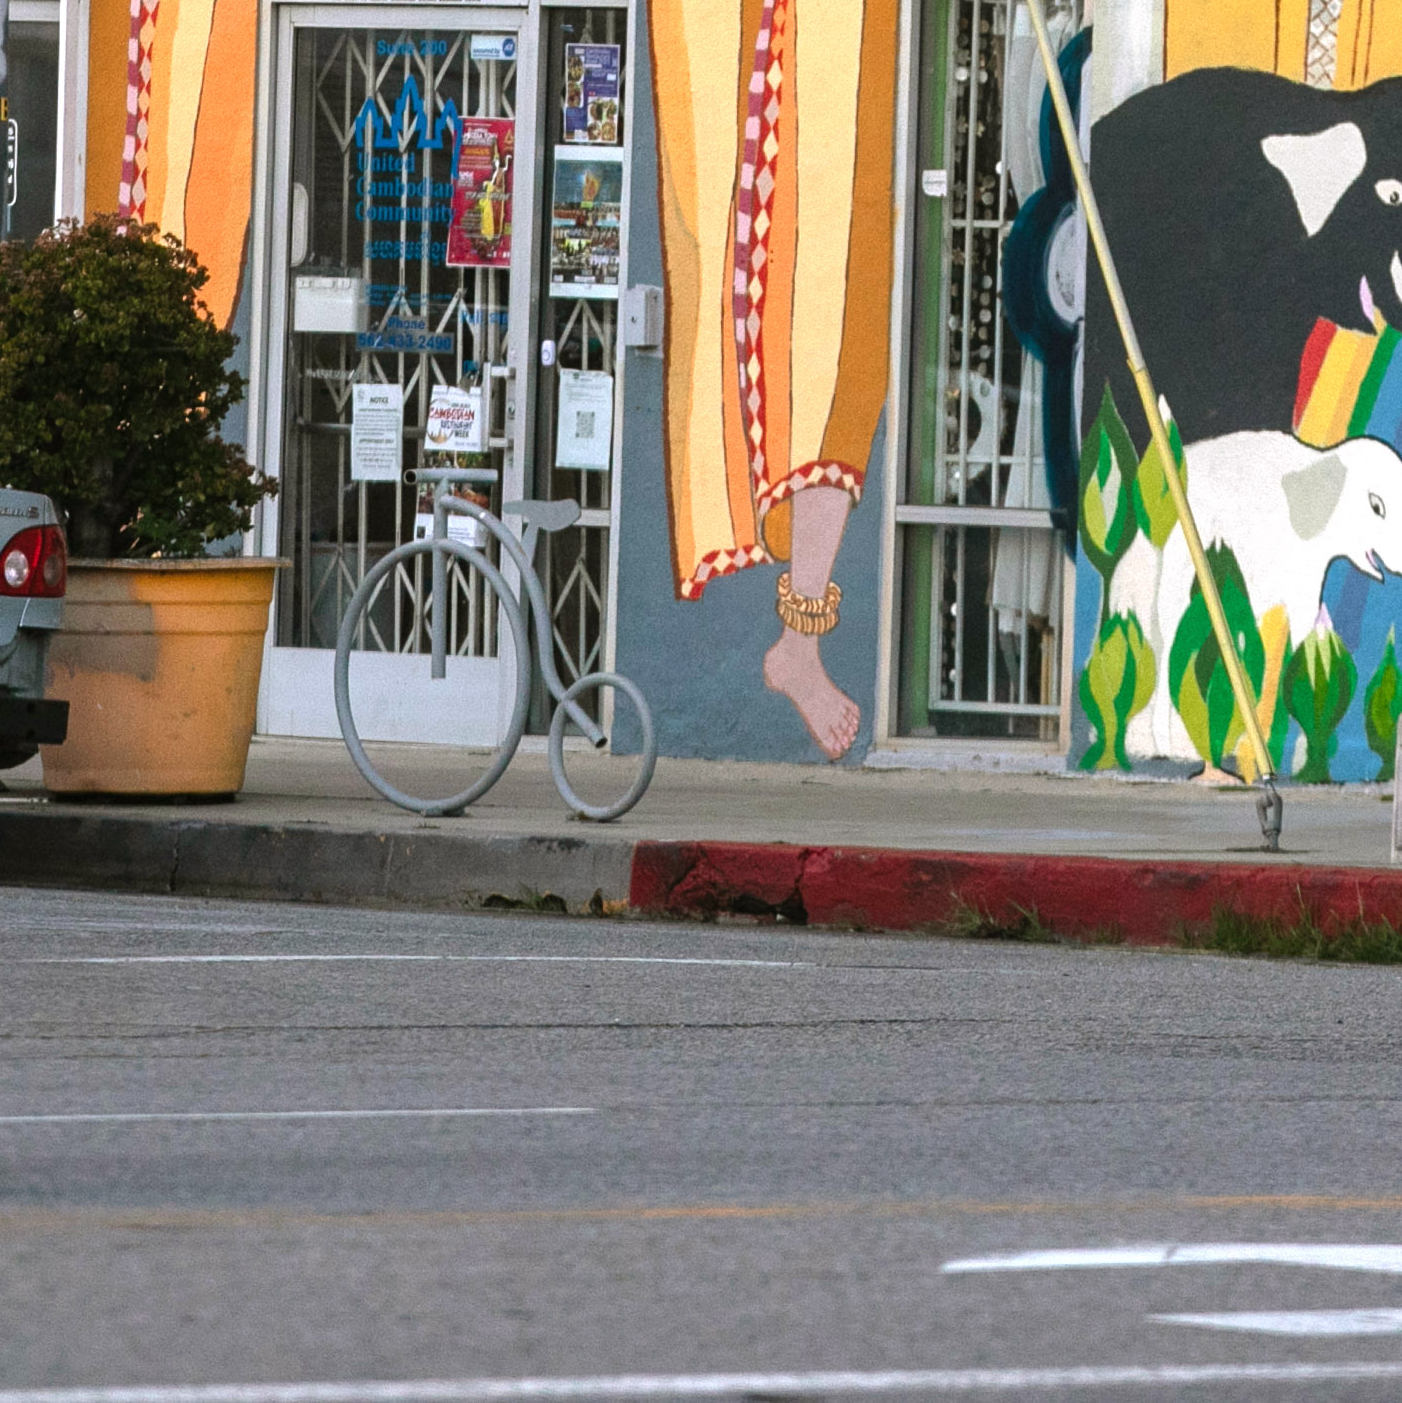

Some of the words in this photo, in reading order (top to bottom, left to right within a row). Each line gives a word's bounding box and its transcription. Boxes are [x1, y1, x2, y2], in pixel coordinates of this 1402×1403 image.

[420, 39, 447, 56] 200
[357, 152, 416, 173] United
[356, 176, 454, 198] Cambodian
[356, 201, 457, 228] Community
[387, 316, 426, 330] Phone
